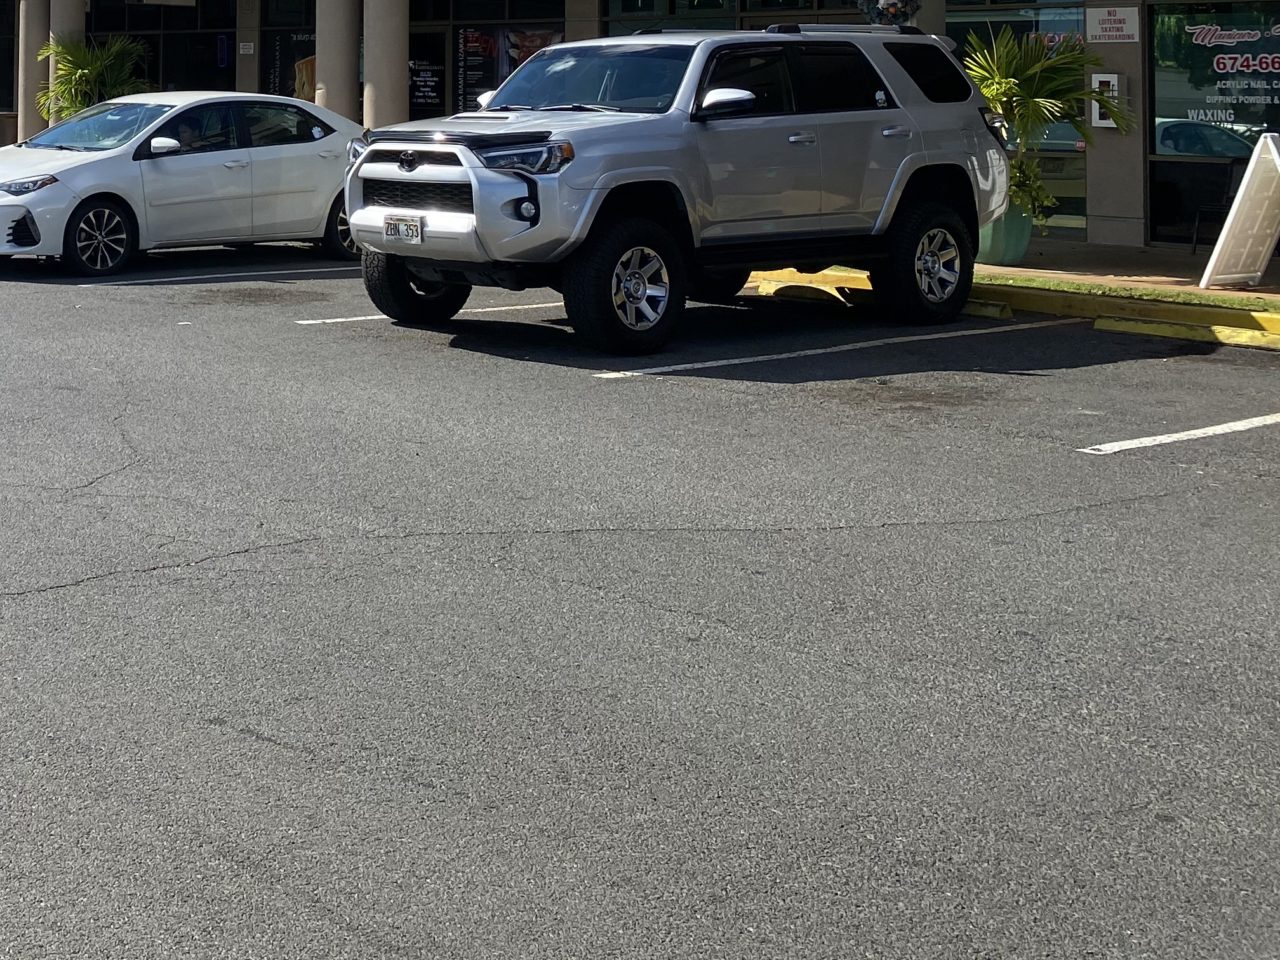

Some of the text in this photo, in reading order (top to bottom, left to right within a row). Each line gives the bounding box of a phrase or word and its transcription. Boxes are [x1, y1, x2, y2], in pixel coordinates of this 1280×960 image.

[1107, 9, 1118, 18] NO
[1098, 18, 1127, 26] LOITERING
[1185, 24, 1262, 47] Manicure
[1216, 80, 1249, 89] ACRYLIC
[1206, 96, 1280, 105] DIPPING POWDER &
[1187, 109, 1235, 122] WAXING
[404, 223, 419, 238] 353
